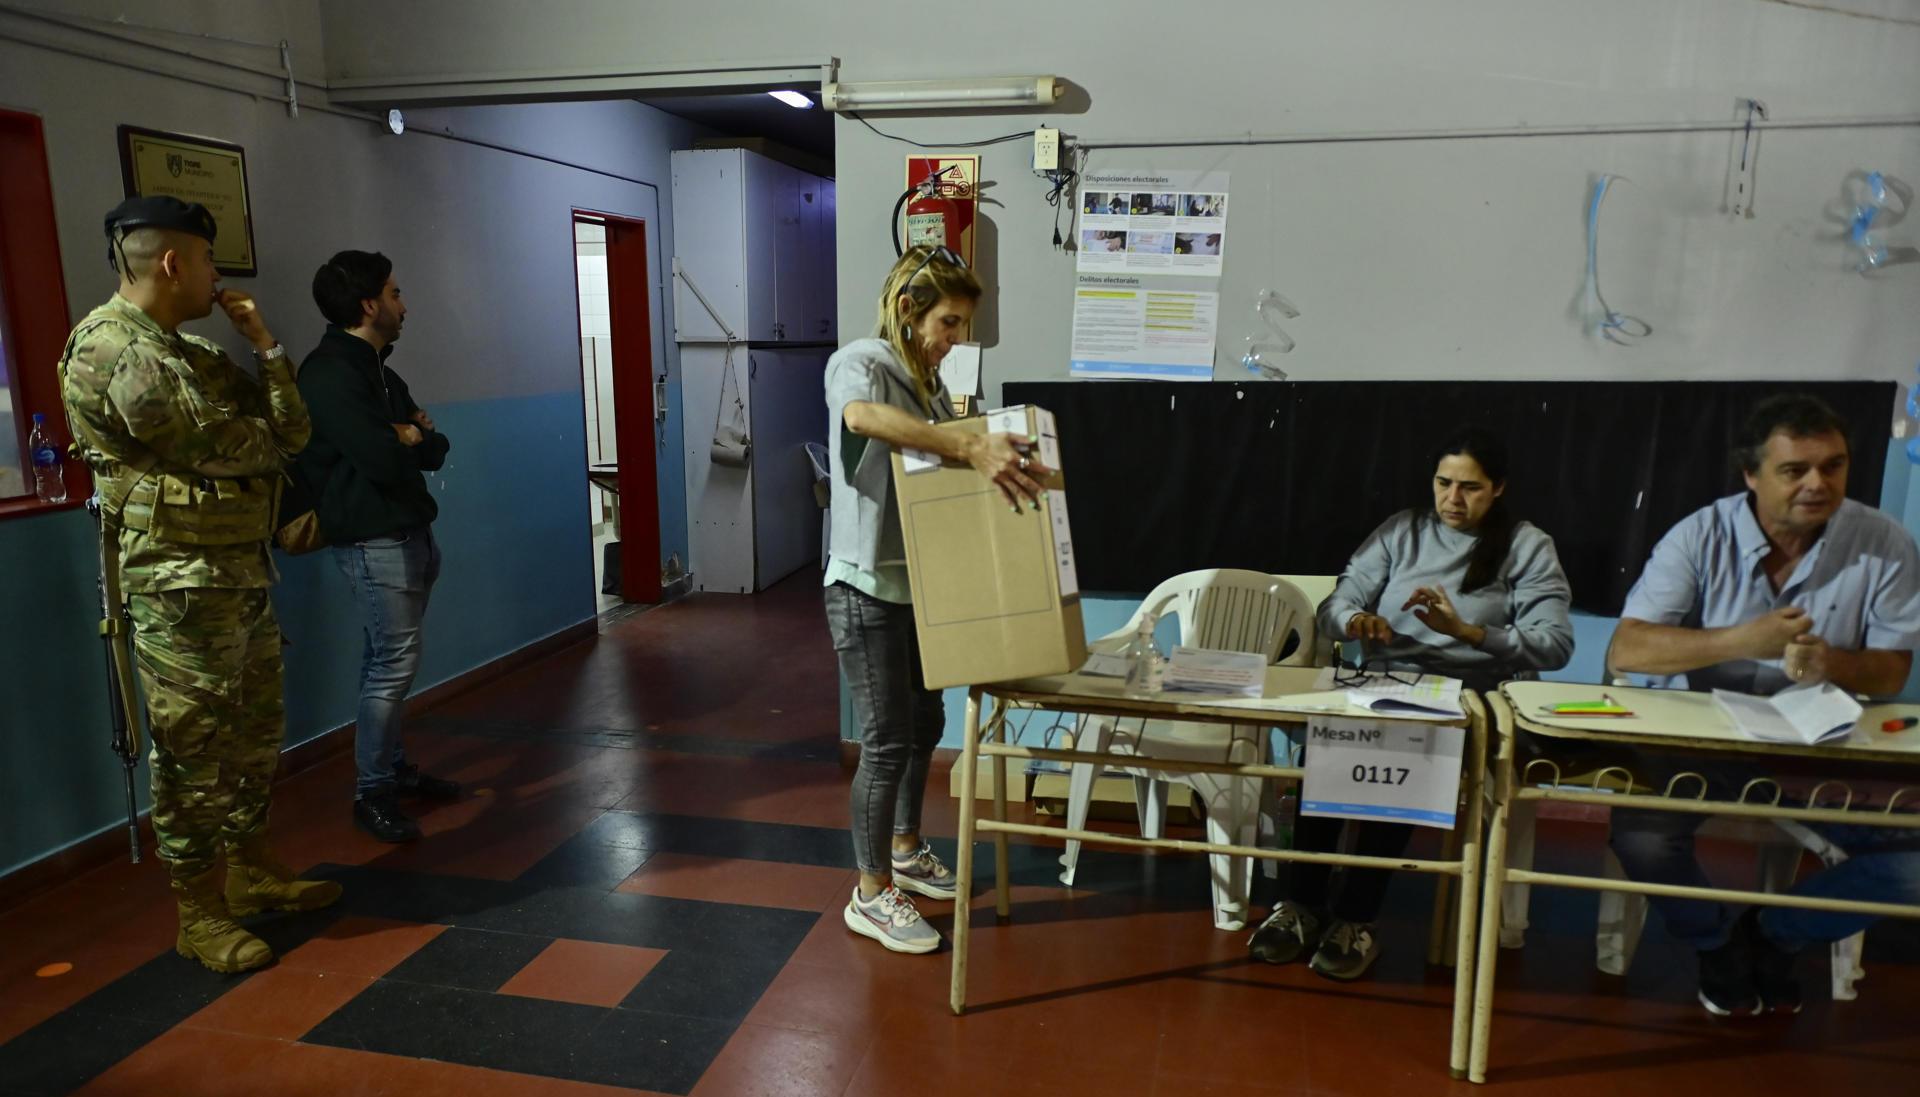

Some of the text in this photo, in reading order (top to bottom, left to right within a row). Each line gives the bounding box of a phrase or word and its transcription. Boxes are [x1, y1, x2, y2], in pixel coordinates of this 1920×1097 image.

[1085, 175, 1130, 183] Disposiciones
[1079, 275, 1140, 284] Delitos electorales
[1312, 726, 1356, 742] Mesa
[1352, 764, 1411, 786] 0117
